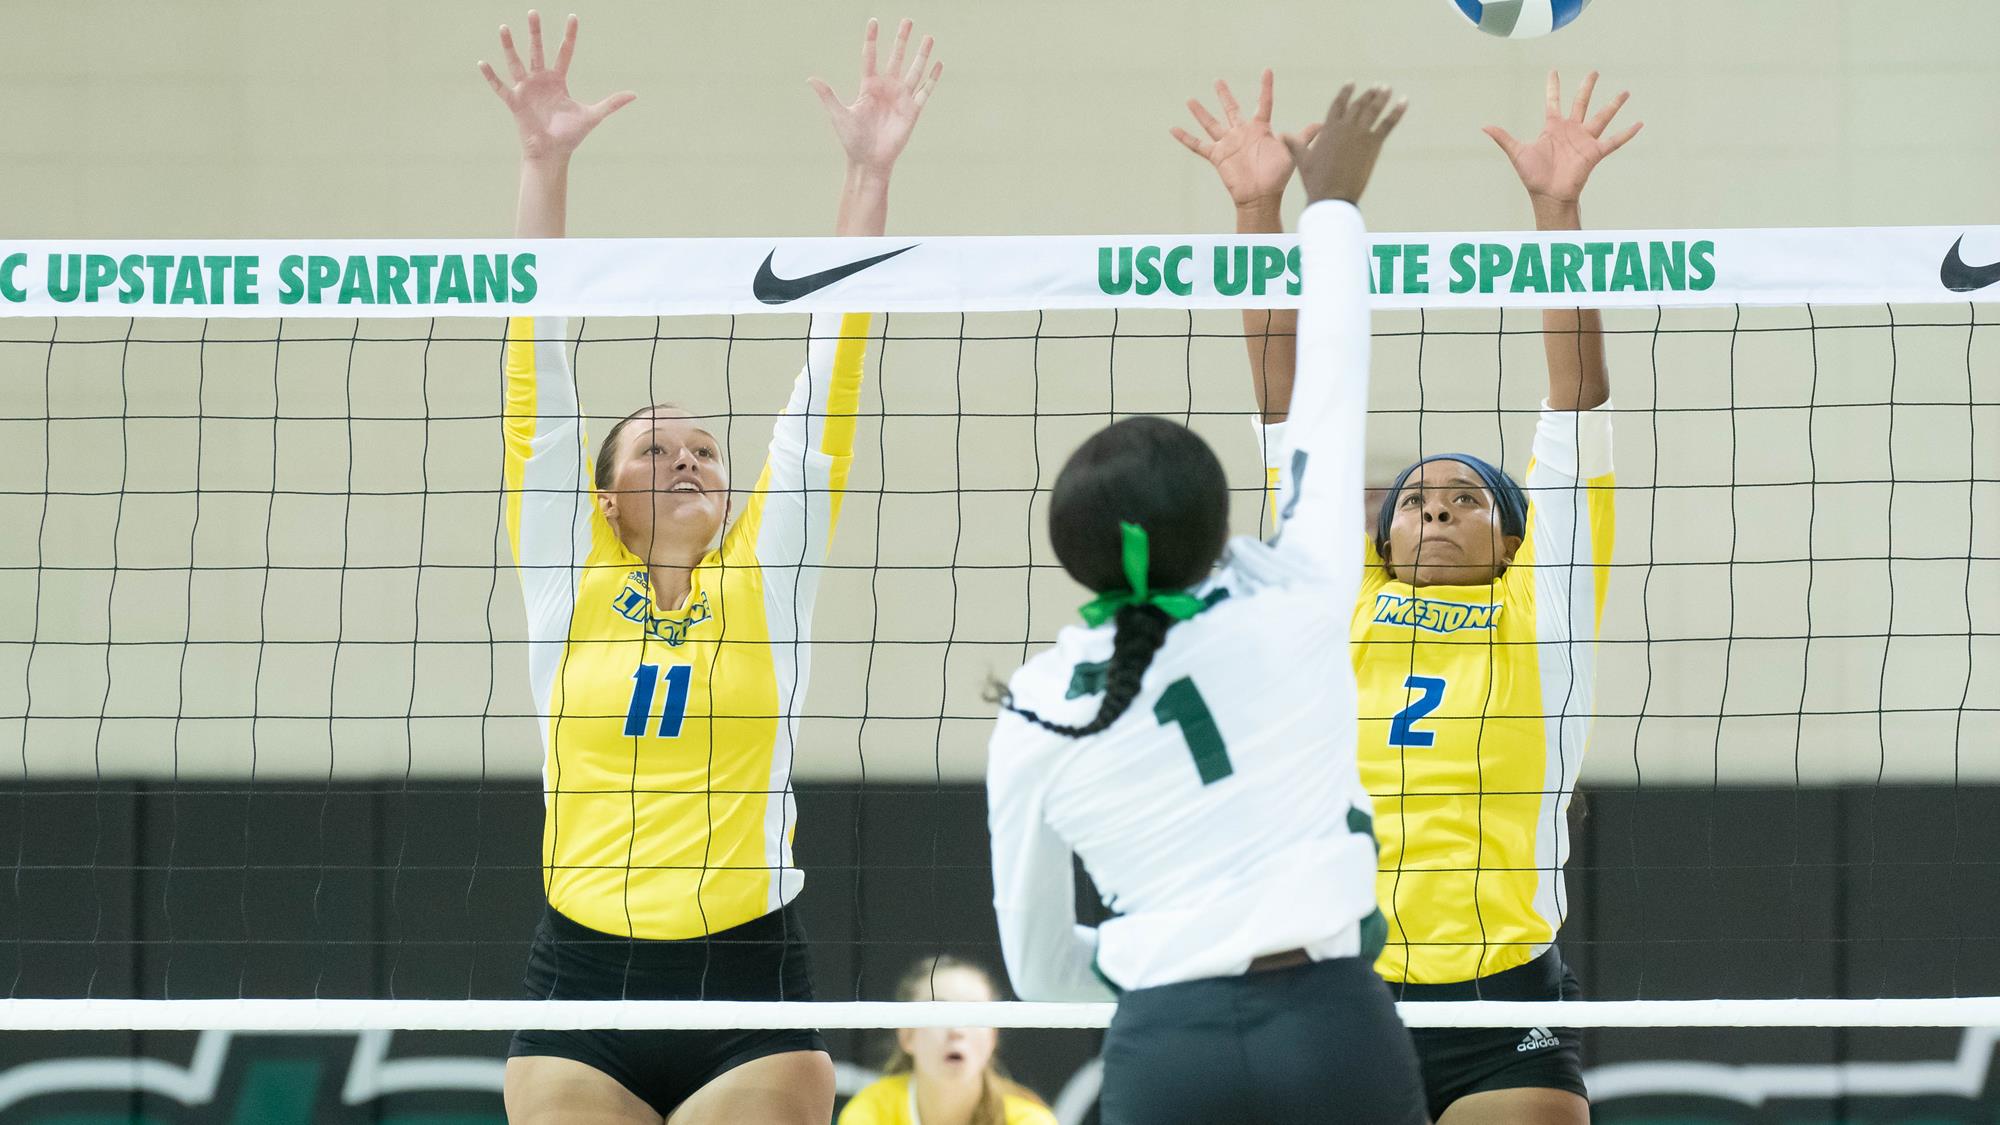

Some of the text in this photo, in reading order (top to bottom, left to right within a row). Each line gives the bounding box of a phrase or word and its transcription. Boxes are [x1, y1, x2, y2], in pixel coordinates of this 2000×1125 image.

[47, 253, 260, 305] UPSTATE
[278, 253, 538, 305] SPARTANS
[1098, 240, 1716, 297] USC UPSTE SPARTANS
[1373, 594, 1503, 634] IMESTON
[622, 664, 692, 738] 11
[1387, 674, 1446, 748] 2
[1153, 676, 1234, 786] 1
[1516, 1036, 1561, 1052] adidas
